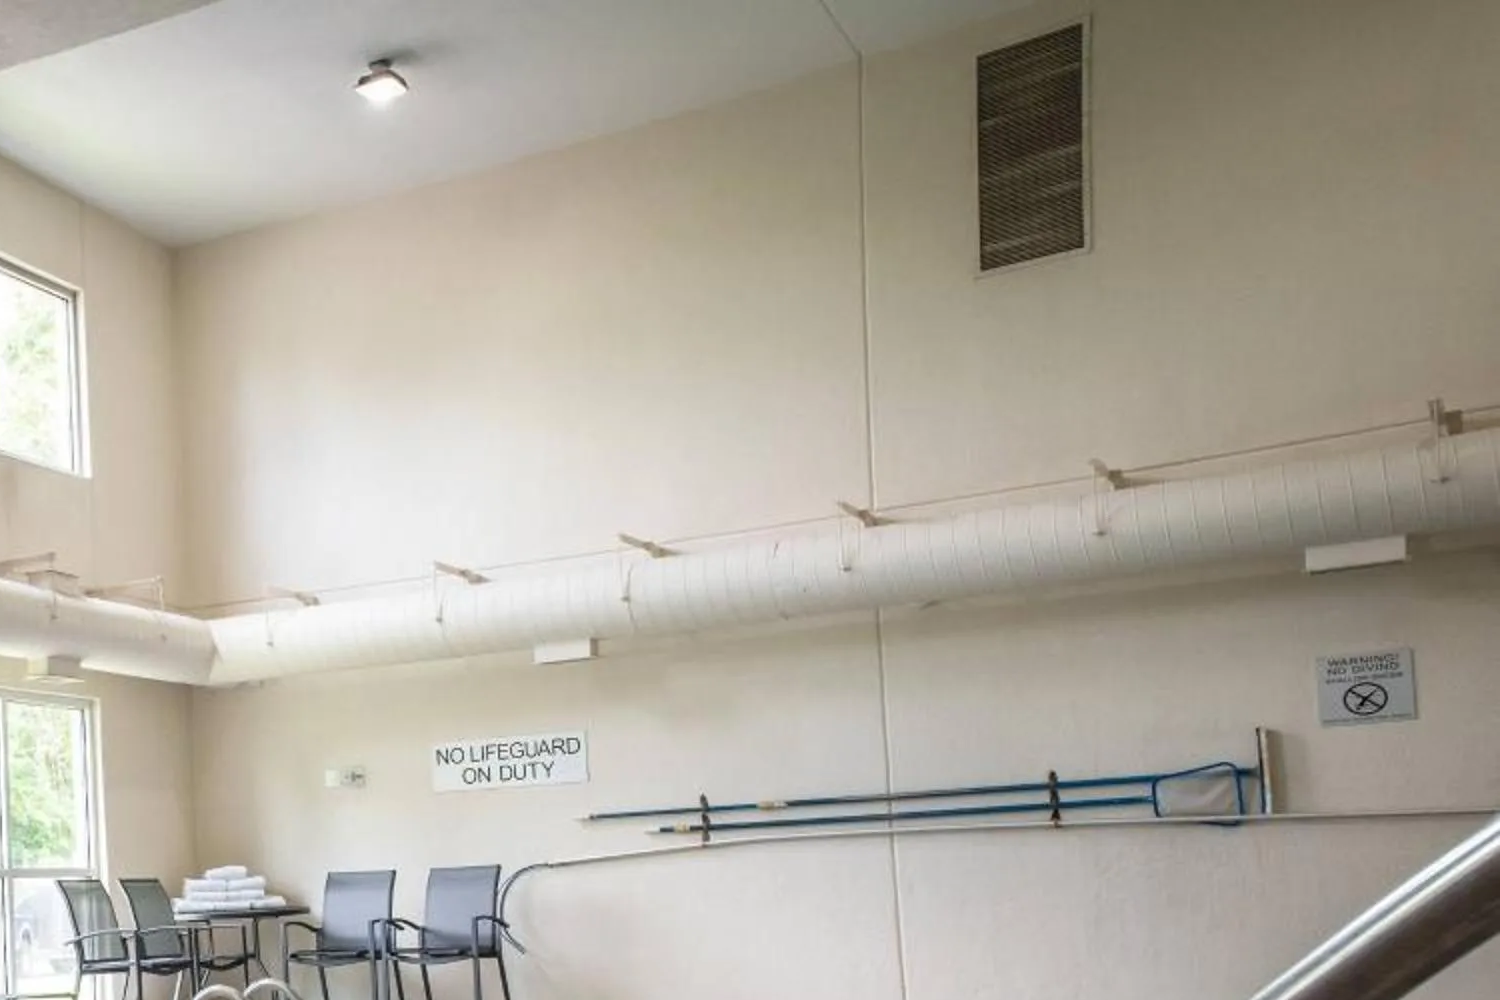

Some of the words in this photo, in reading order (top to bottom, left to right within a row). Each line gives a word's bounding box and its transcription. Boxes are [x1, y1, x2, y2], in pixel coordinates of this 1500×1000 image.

[1327, 667, 1347, 675] NO
[436, 747, 465, 766] NO
[470, 737, 581, 763] LIFEGUARD
[462, 767, 491, 785] ON
[499, 761, 554, 781] DUTY
